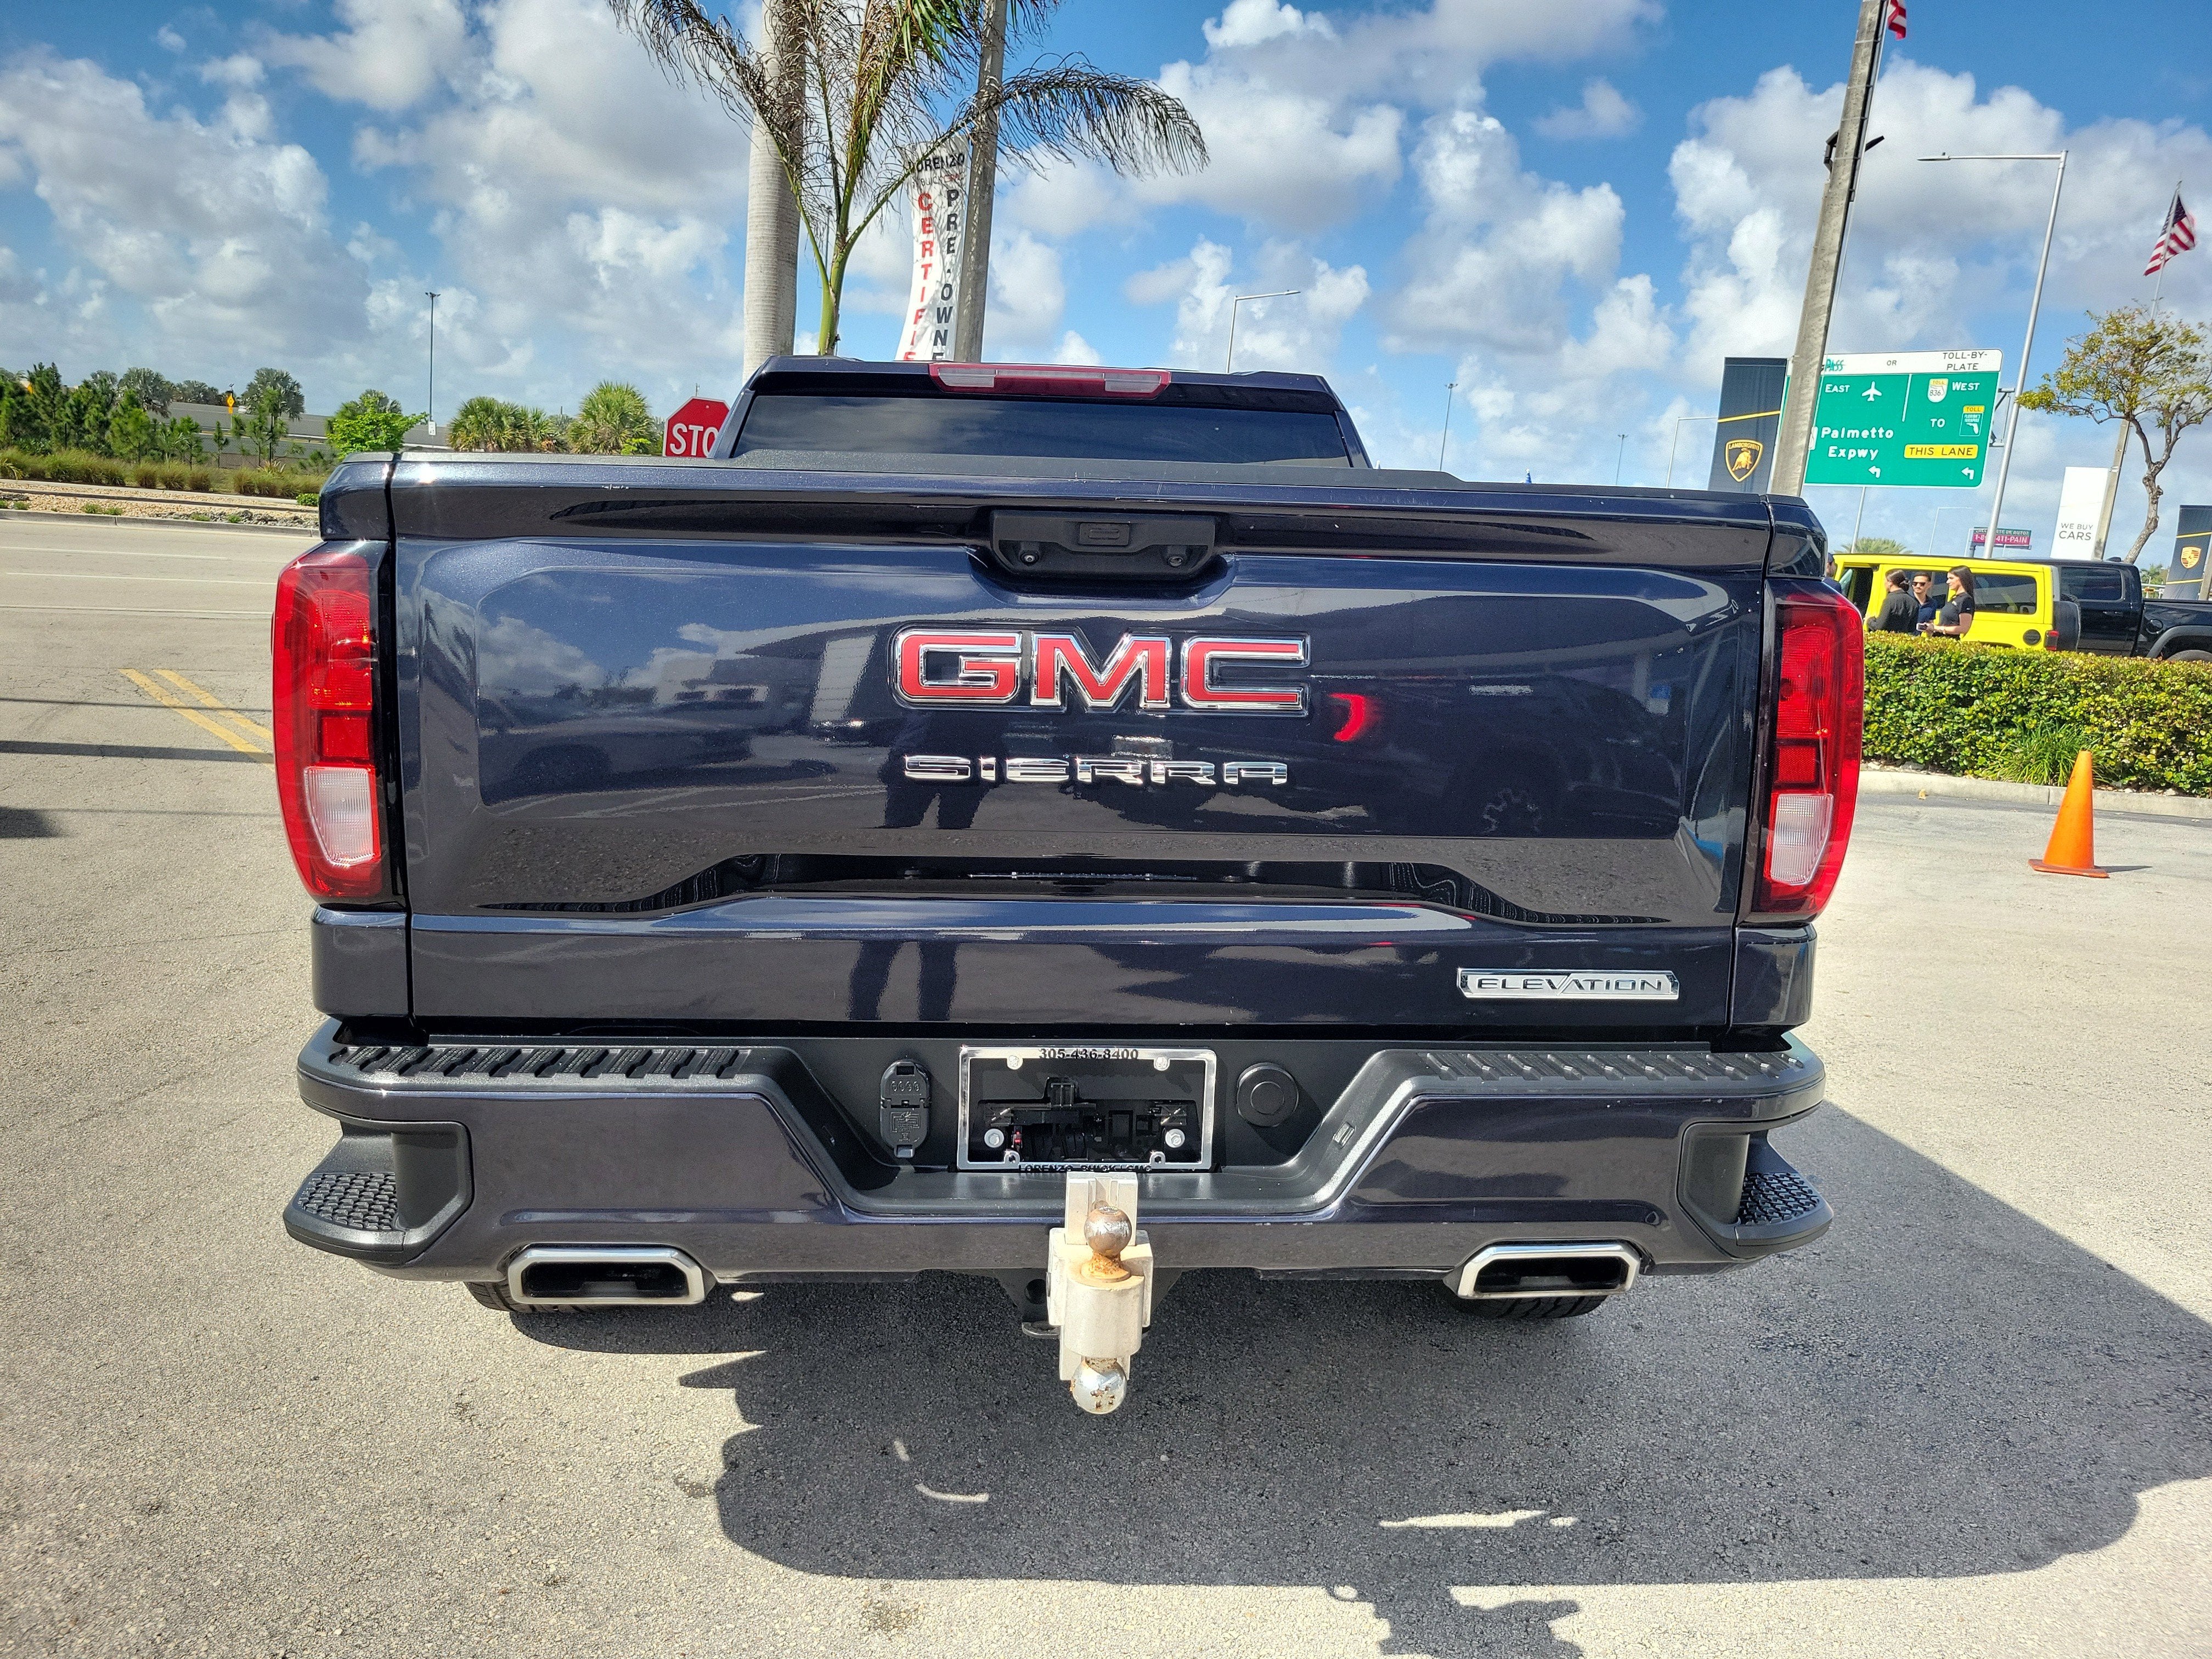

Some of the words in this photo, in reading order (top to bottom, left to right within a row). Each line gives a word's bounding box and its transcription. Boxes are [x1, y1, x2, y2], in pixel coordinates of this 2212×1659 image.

[903, 193, 933, 361] CERTIFIE
[1946, 363, 1979, 371] PLATE
[1825, 383, 1850, 393] EAST
[1952, 381, 1980, 391] WEST
[1930, 418, 1945, 428] TO
[1820, 426, 1894, 439] Palmetto
[669, 423, 720, 459] STO
[1828, 445, 1879, 461] Expwy
[1909, 447, 1934, 455] THIS
[1941, 447, 1974, 456] LANE
[2058, 531, 2092, 540] CARS
[891, 628, 1310, 715] GMC
[905, 755, 1288, 786] SIERRA
[1476, 976, 1663, 991] ELEVATION
[1039, 1048, 1139, 1060] 305-436-8400
